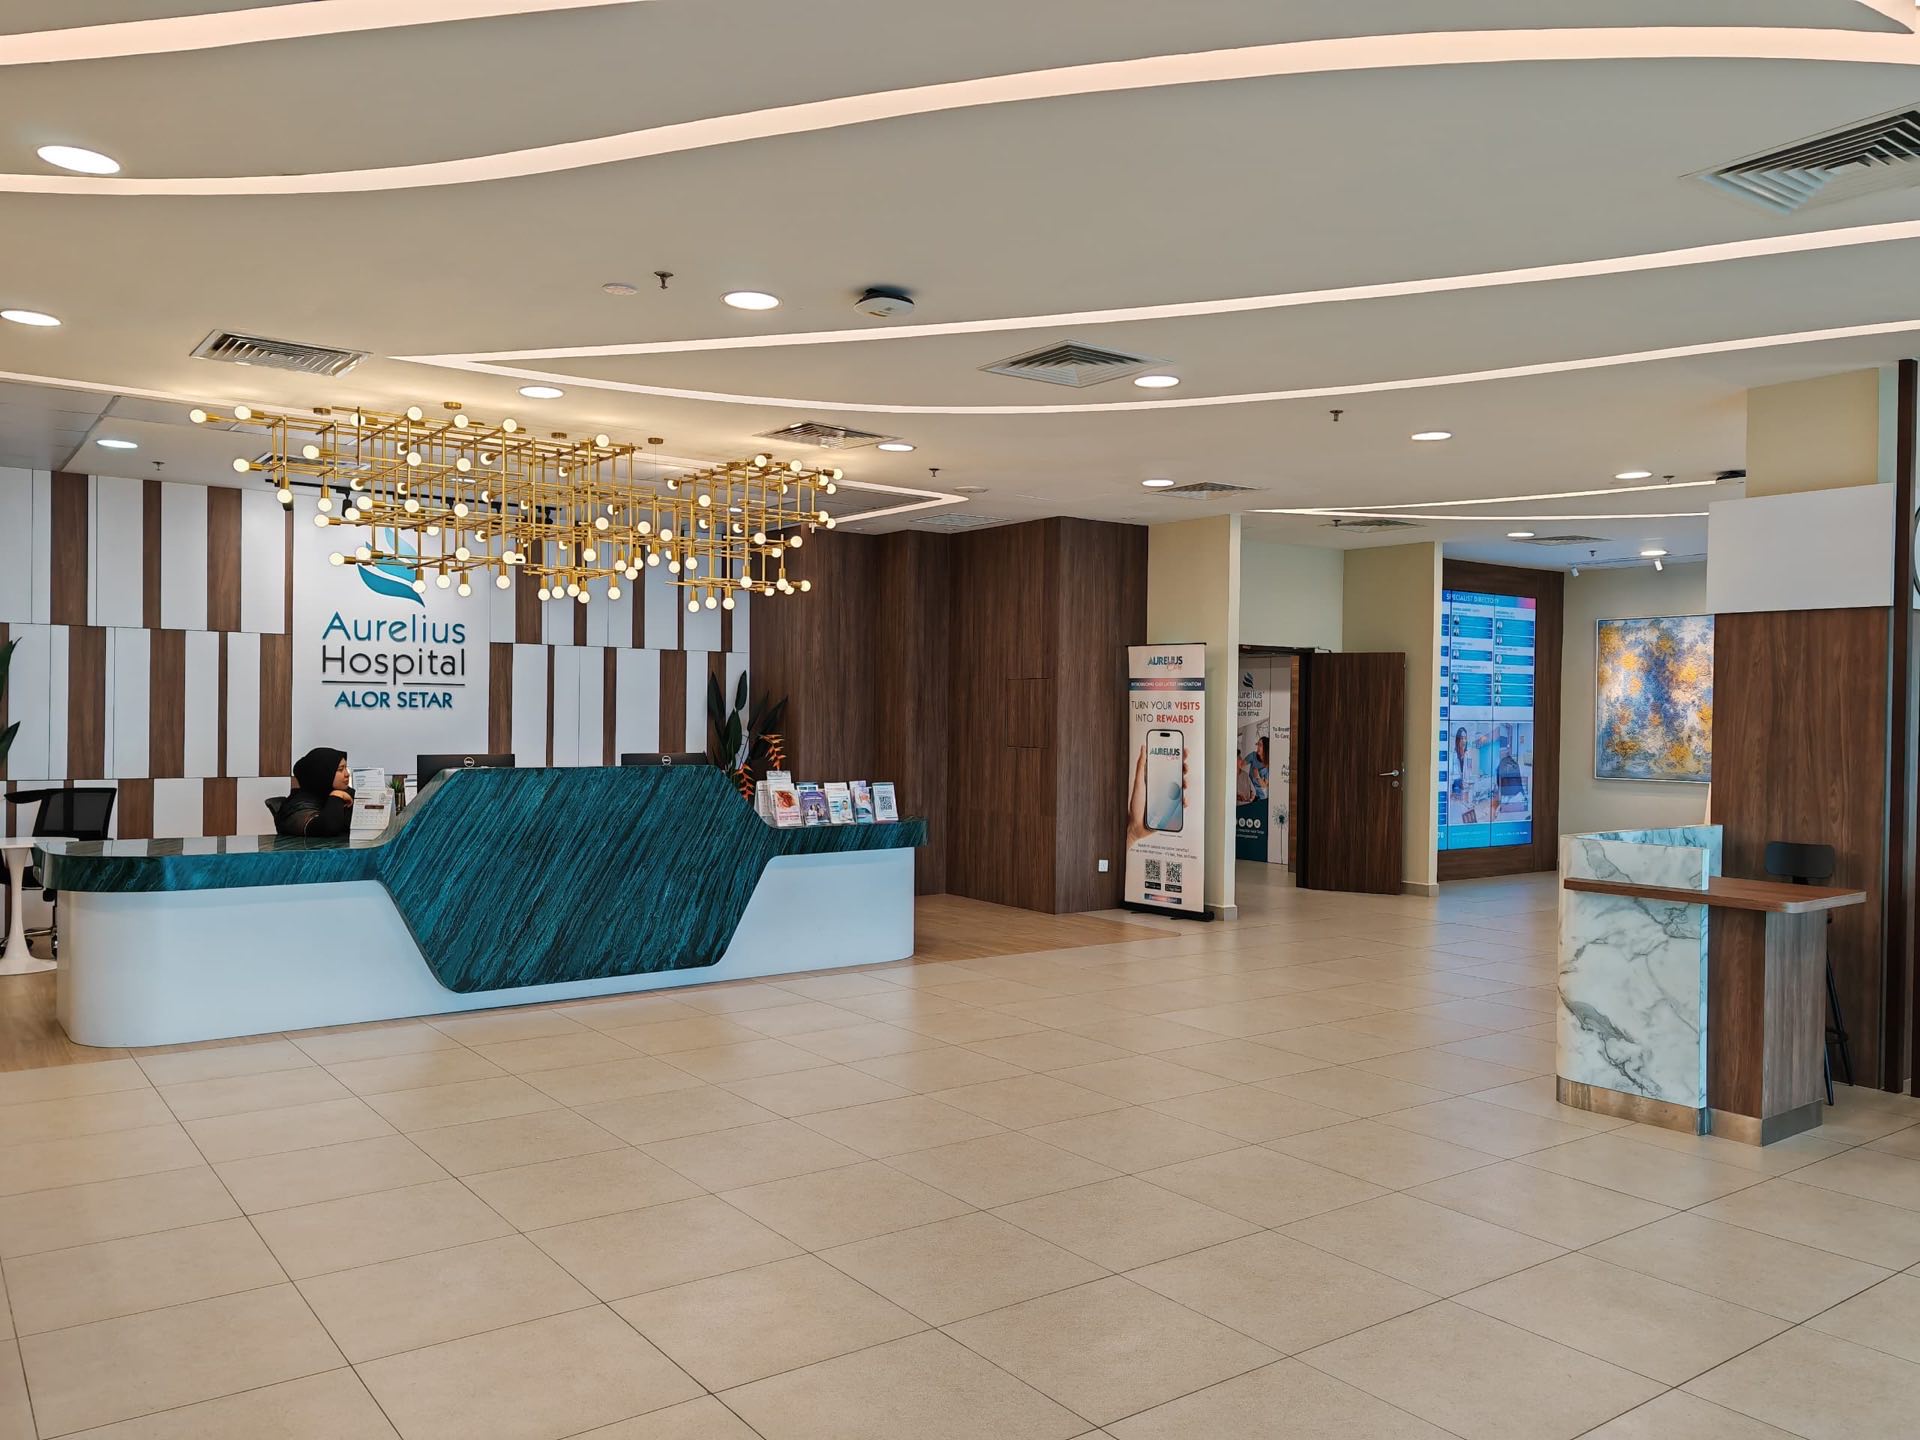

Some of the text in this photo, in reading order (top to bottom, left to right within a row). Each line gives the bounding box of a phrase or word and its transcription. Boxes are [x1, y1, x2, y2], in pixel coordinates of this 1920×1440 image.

[322, 611, 466, 644] Aurelius
[322, 645, 466, 685] Hospital
[1147, 656, 1183, 666] AURELIUS
[334, 690, 453, 709] ALOR SETAR
[1238, 690, 1263, 699] urelius
[1131, 700, 1201, 711] TURN YOUR VISITS
[1238, 699, 1263, 711] ospital
[1135, 713, 1195, 724] INTO REWARDS
[1150, 747, 1180, 756] AURELIUS
